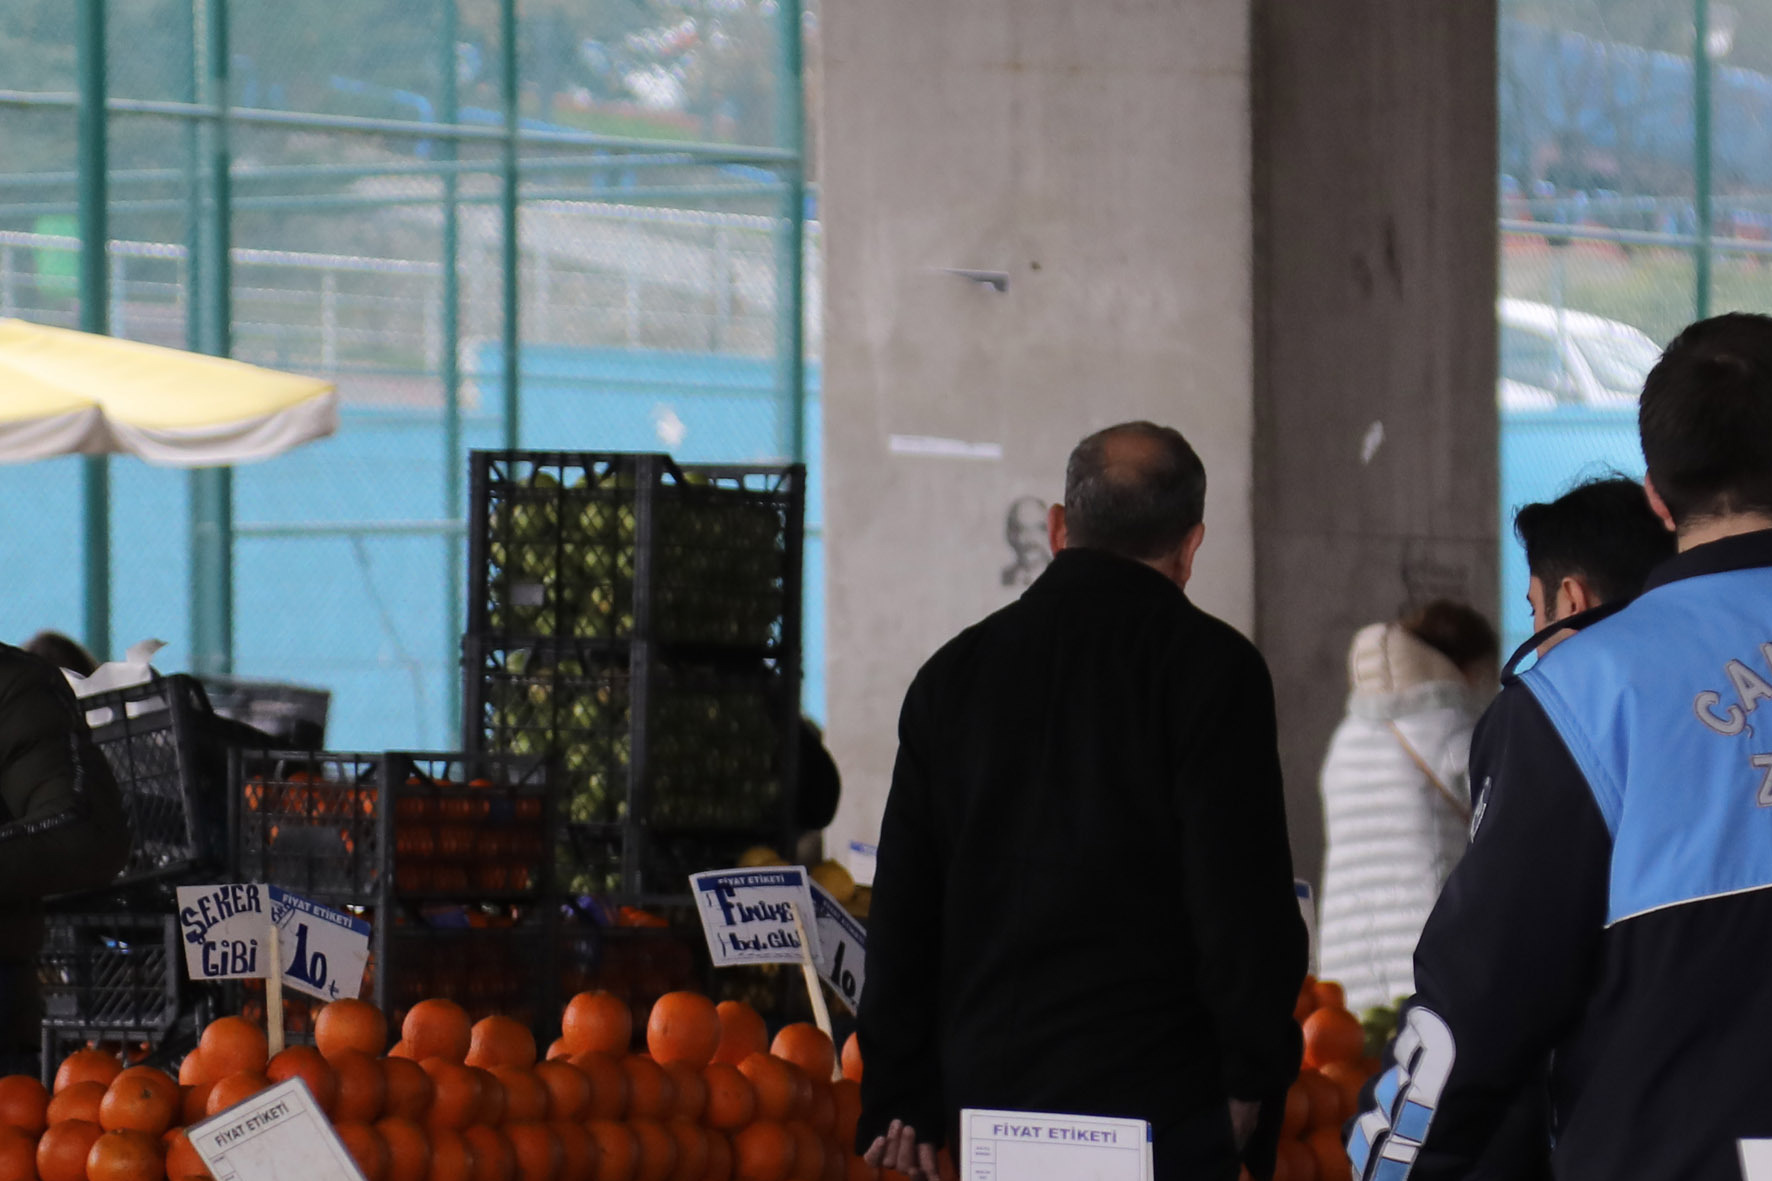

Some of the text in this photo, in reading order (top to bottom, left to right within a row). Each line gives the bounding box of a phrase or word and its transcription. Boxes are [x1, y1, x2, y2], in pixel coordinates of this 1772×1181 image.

[180, 884, 262, 945] ŞEKER
[282, 893, 353, 928] FİYAT ETİKETİ
[202, 939, 258, 977] GİBİ
[284, 922, 328, 989] 10
[831, 940, 857, 997] 10
[214, 1101, 290, 1148] FİYAT ETİKETİ
[993, 1122, 1118, 1144] FİYAT ETİKETİ
